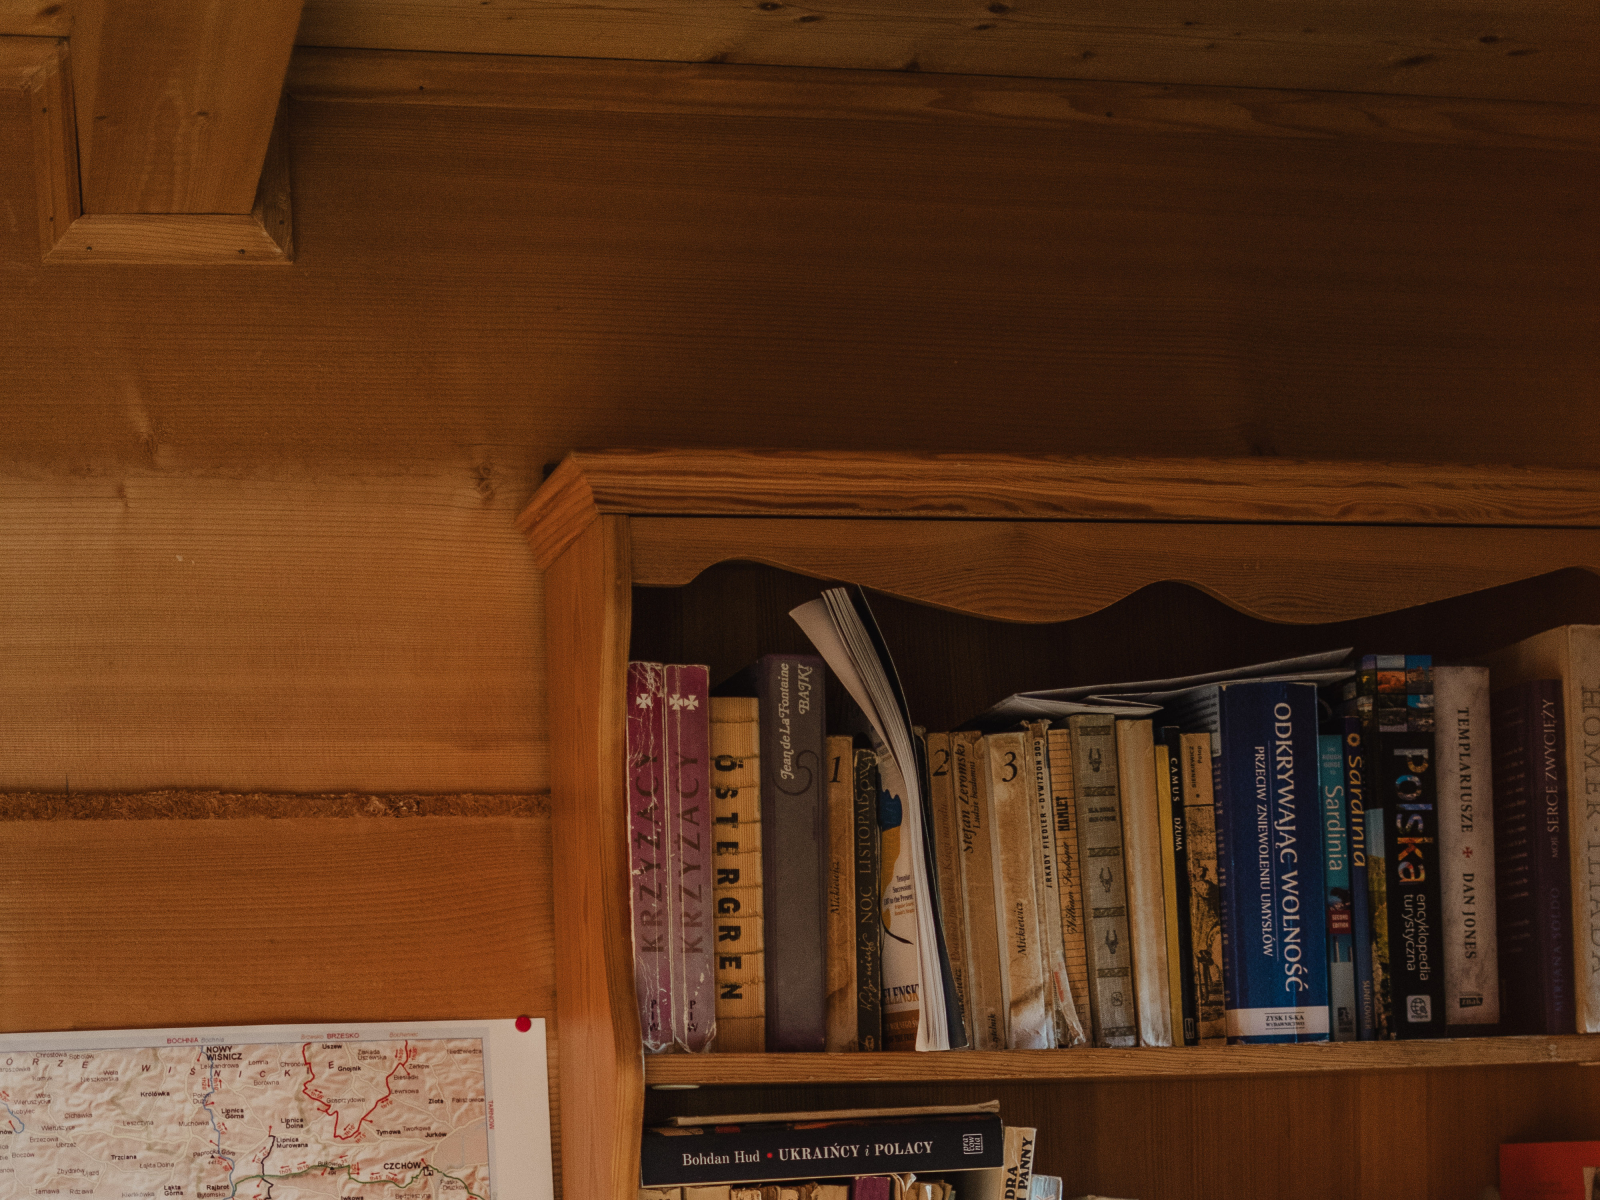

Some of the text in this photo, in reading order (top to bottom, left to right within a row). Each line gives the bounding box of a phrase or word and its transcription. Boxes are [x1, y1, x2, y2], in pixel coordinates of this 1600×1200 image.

[798, 663, 813, 715] BAJKI
[829, 755, 841, 783] 1
[932, 748, 950, 777] 2
[1001, 751, 1018, 783] 3
[1188, 745, 1197, 789] SIENKIEWICZ
[1457, 707, 1473, 833] TEMPLARIUSZE
[1541, 698, 1557, 781] ZWYCIĘŻY
[970, 761, 981, 829] Ludzie bezdomni
[1036, 760, 1046, 803] DYWIZJON
[1170, 757, 1184, 851] CAMUS DŻUMA
[1348, 755, 1366, 867] Sardinia
[1547, 786, 1559, 833] SERCE
[962, 809, 977, 853] Stefan
[1040, 812, 1050, 850] FIEDLER
[1056, 795, 1070, 832] HAMLET
[1324, 785, 1347, 871] Sardinia
[1393, 748, 1434, 883] Polska
[634, 753, 664, 953] KRZYŻACY
[674, 751, 703, 954] KRZYŻACY
[714, 754, 744, 1000] ÖSTERGREN
[1254, 746, 1276, 957] PRZECIW ZNIEWOLENIU UMYSŁÓW
[1273, 702, 1309, 992] ODKRYWAJĄC WOLNOŚĆ
[859, 886, 873, 924] NOC
[1015, 902, 1027, 956] Mickiewicz
[1401, 893, 1416, 972] turystyczna
[1462, 873, 1477, 959] DAN JONES
[1416, 893, 1432, 982] encyklopedia
[384, 1161, 422, 1170] CZCHÓW
[682, 1141, 934, 1166] Bohdan Hud UKRAIŃCY i POLACY
[1018, 1136, 1034, 1191] PANNY
